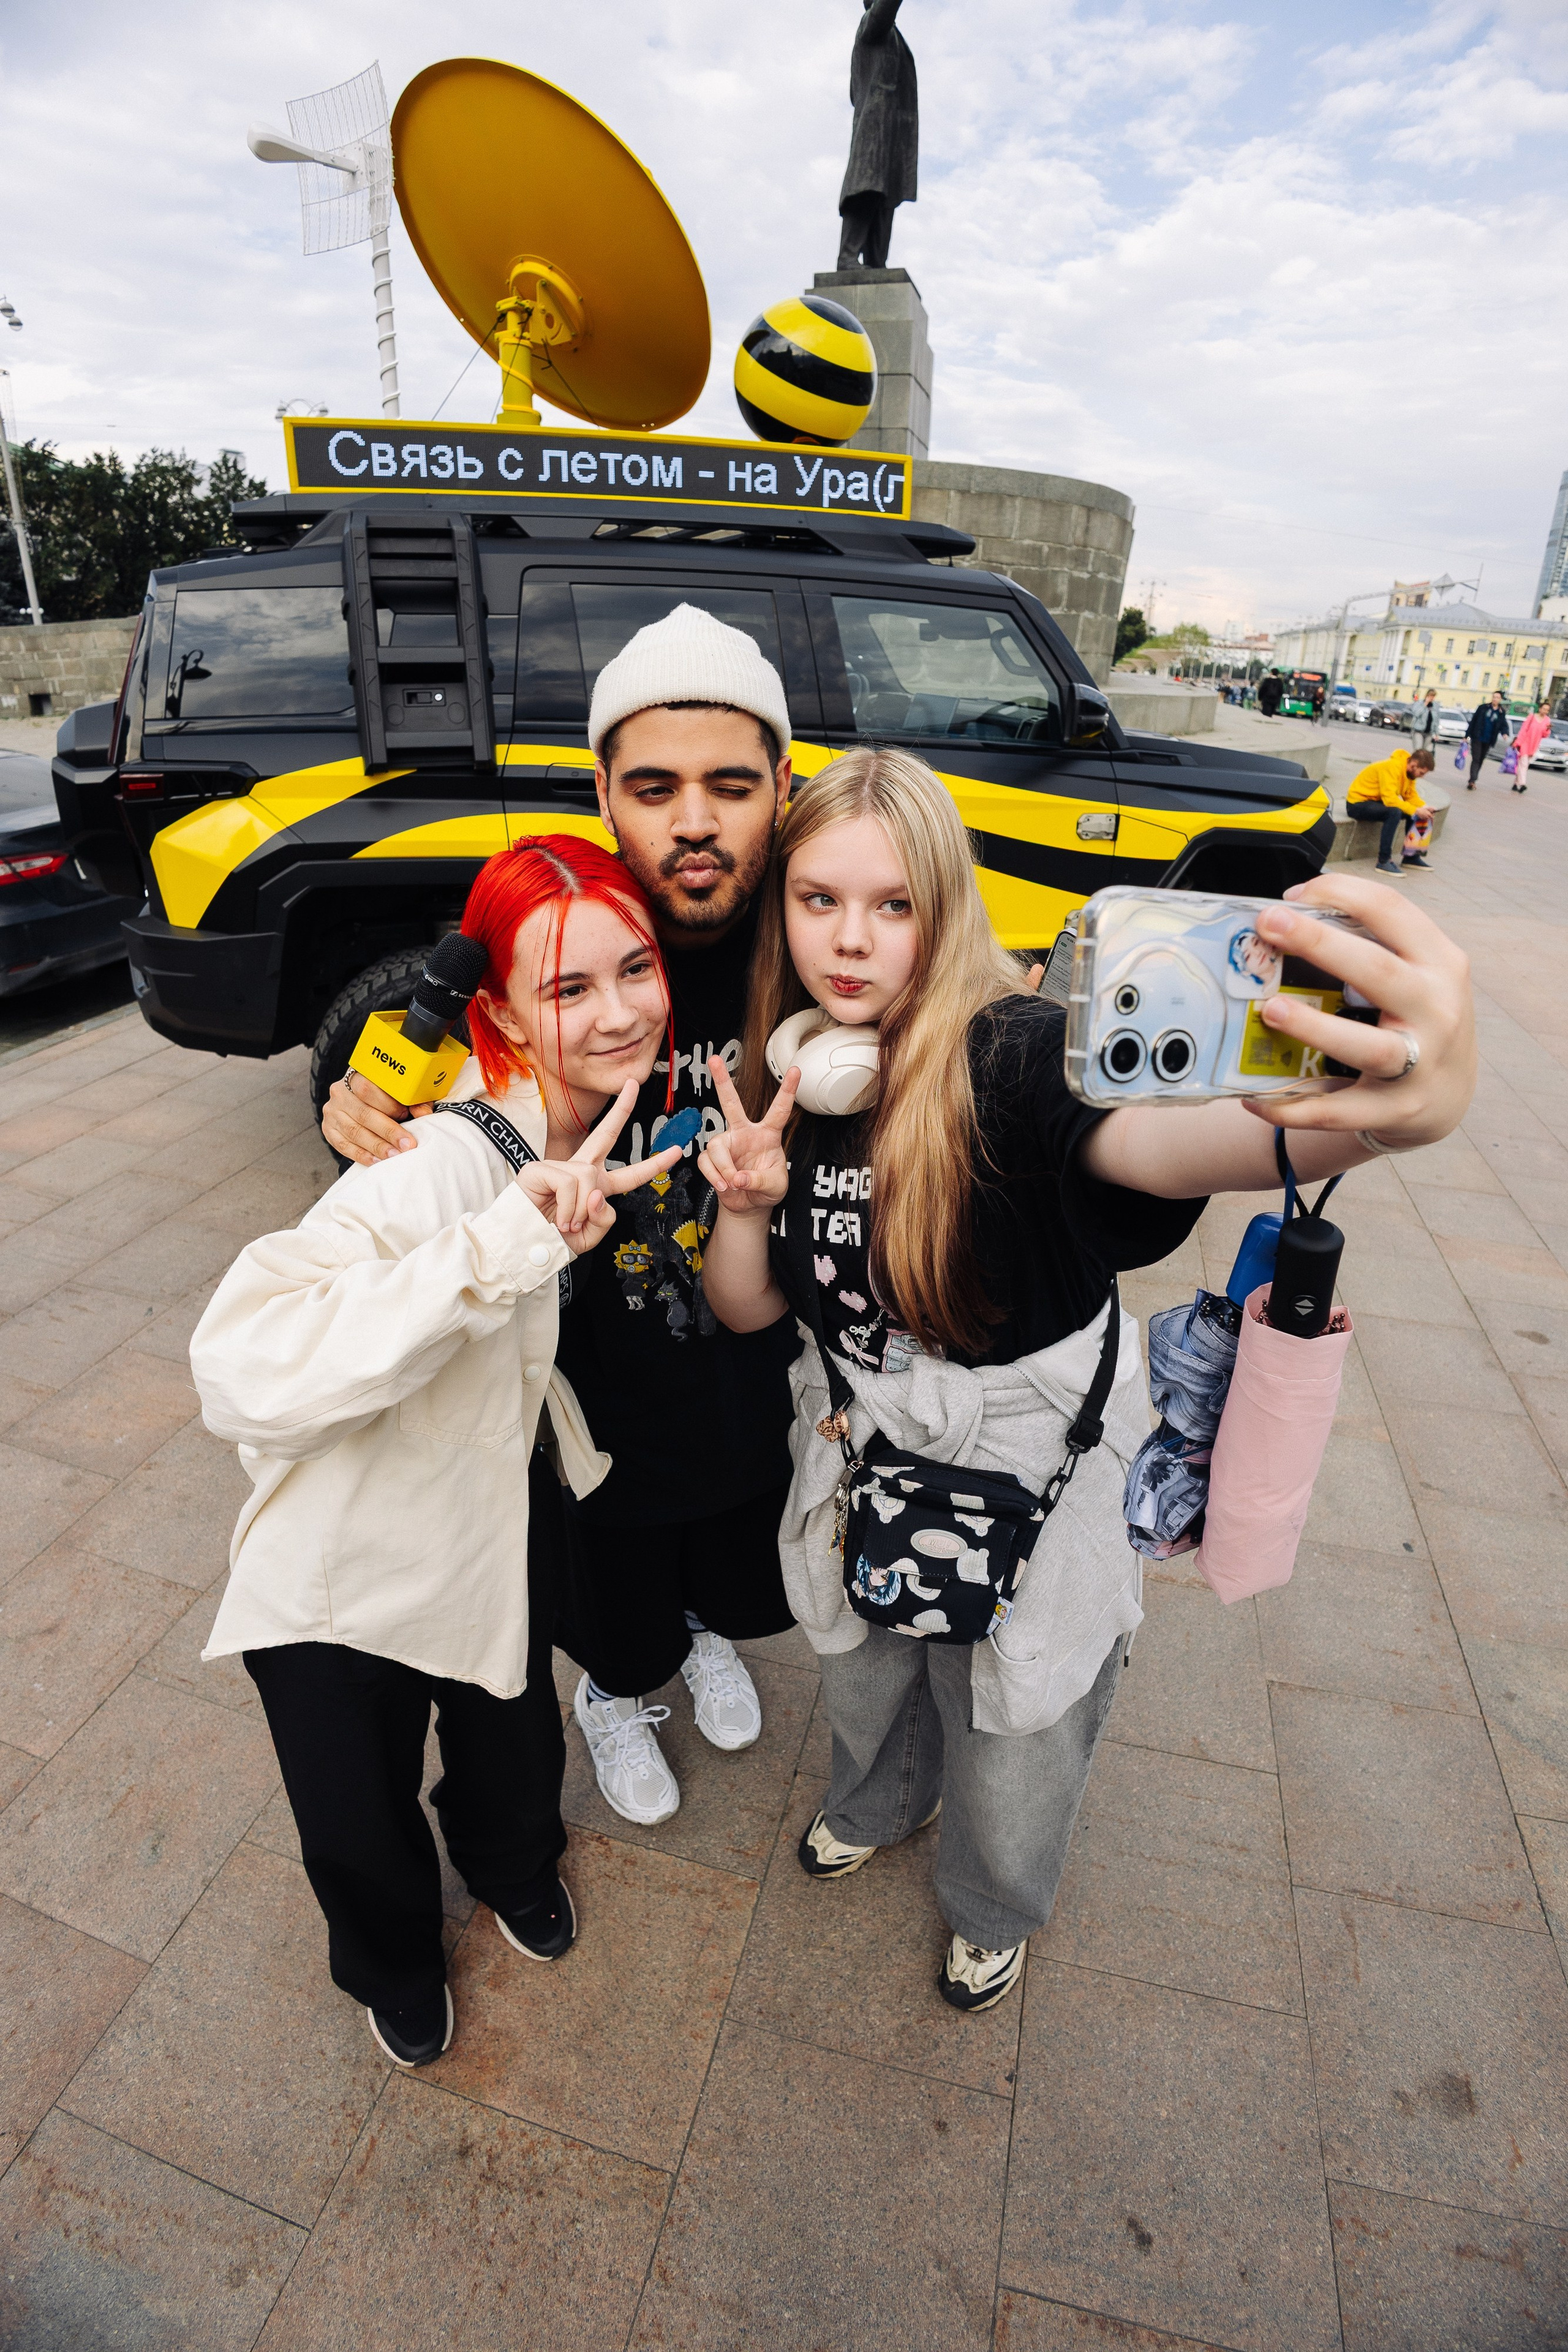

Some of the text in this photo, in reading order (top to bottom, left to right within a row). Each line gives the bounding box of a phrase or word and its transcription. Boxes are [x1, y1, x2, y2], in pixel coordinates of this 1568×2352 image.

[328, 430, 484, 479] Связь
[497, 448, 524, 480] с
[538, 449, 684, 489] летом
[728, 461, 778, 494] на
[371, 1046, 407, 1076] news
[559, 1267, 569, 1294] MPS
